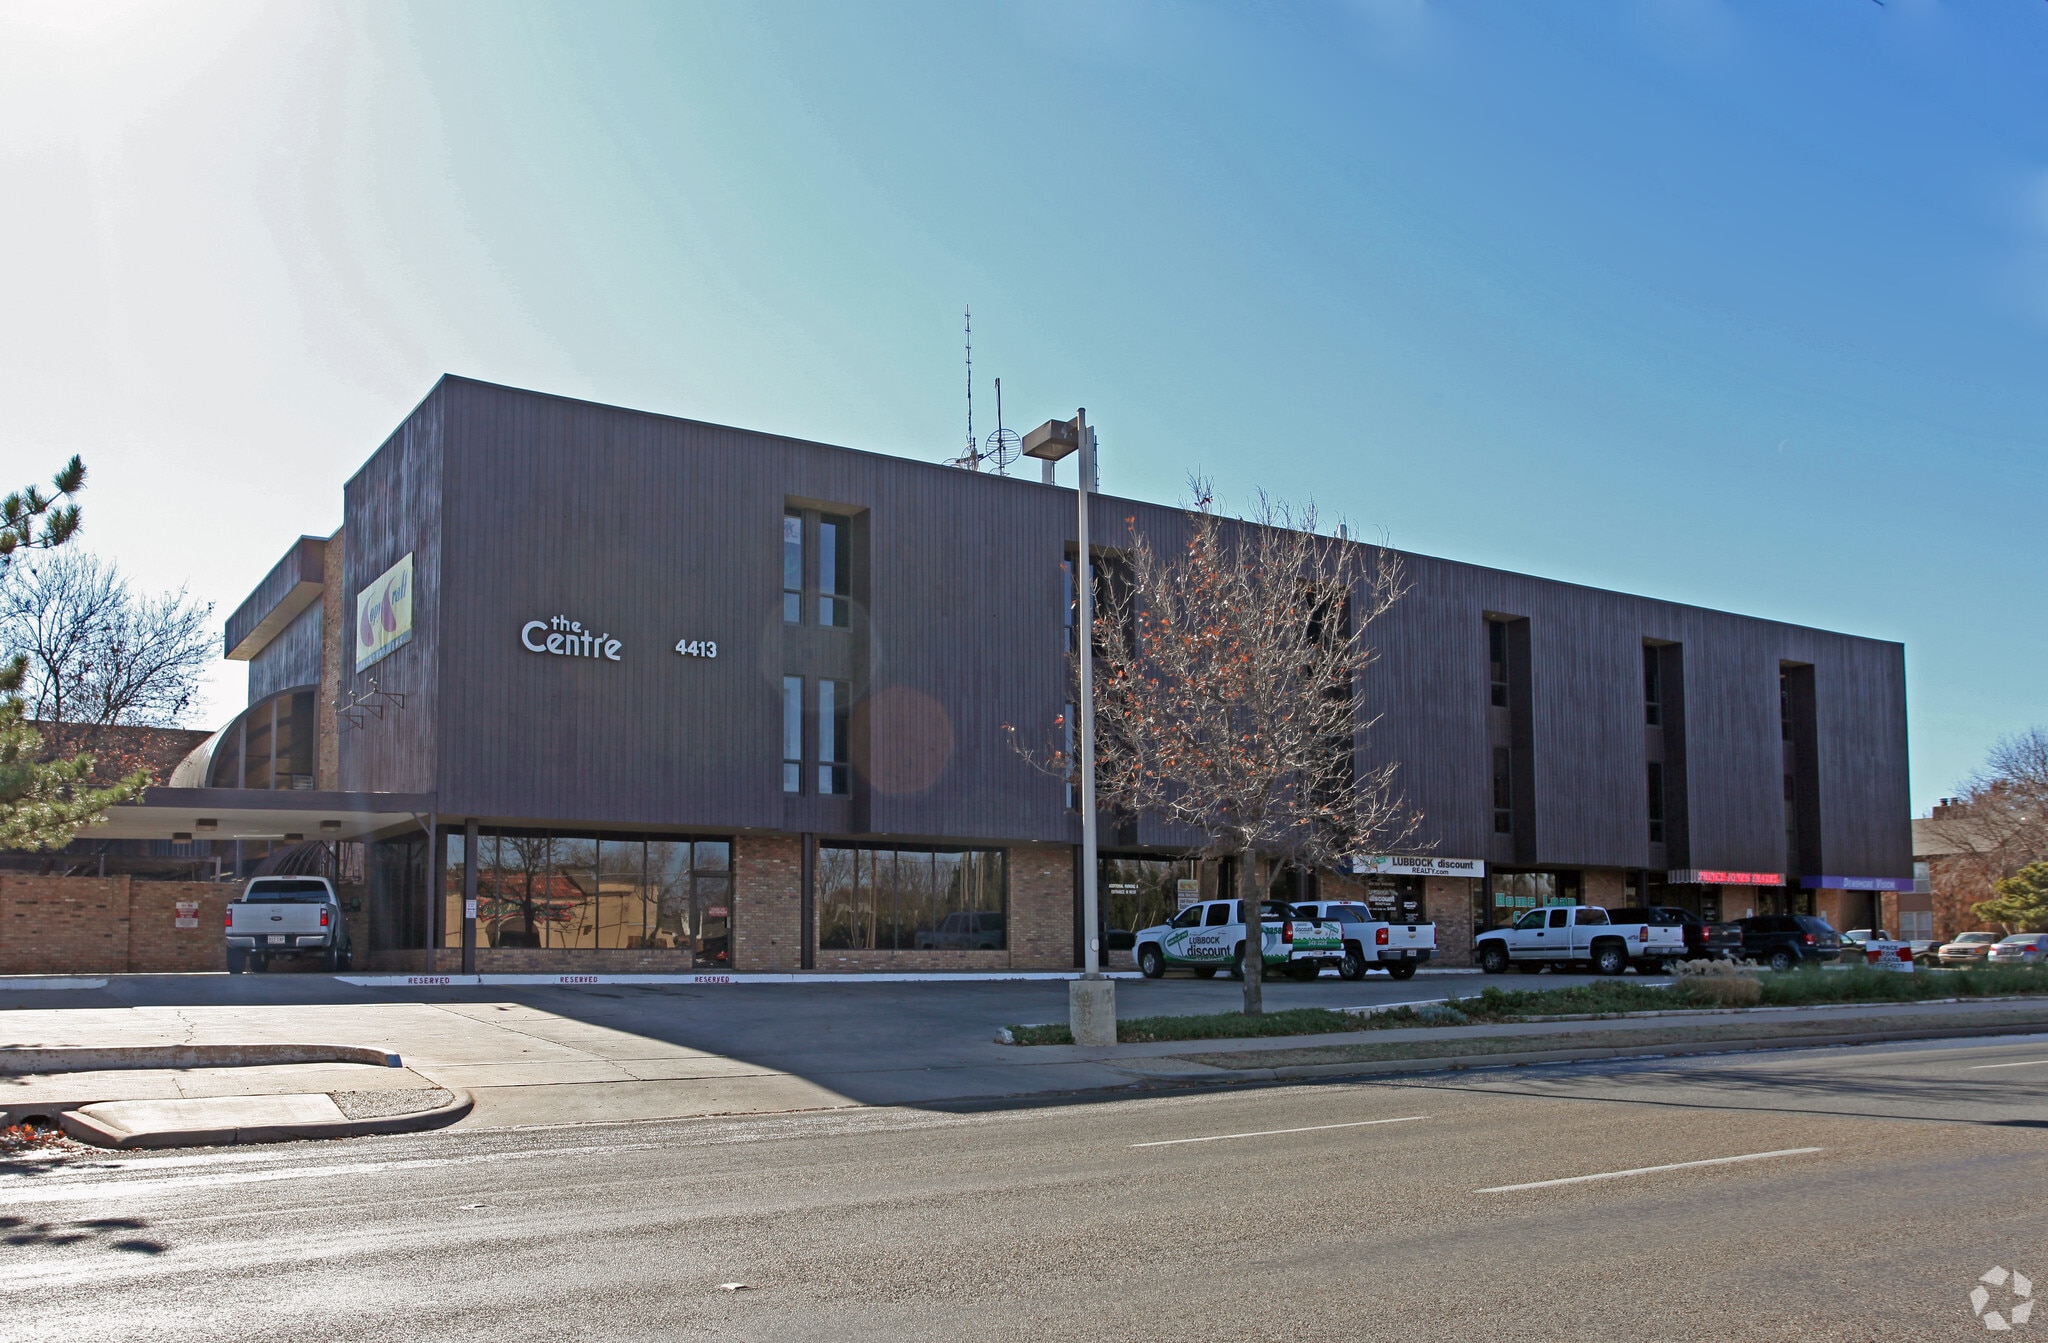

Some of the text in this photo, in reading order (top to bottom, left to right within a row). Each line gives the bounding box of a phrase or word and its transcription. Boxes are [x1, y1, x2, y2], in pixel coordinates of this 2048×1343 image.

[551, 614, 582, 633] the
[675, 639, 717, 658] 4413
[1392, 857, 1474, 870] LUBBOCK discount
[1411, 867, 1449, 875] REALTY.com
[1495, 892, 1577, 908] Home Loan
[1188, 936, 1220, 945] LUBBOCK
[1187, 945, 1232, 957] discount
